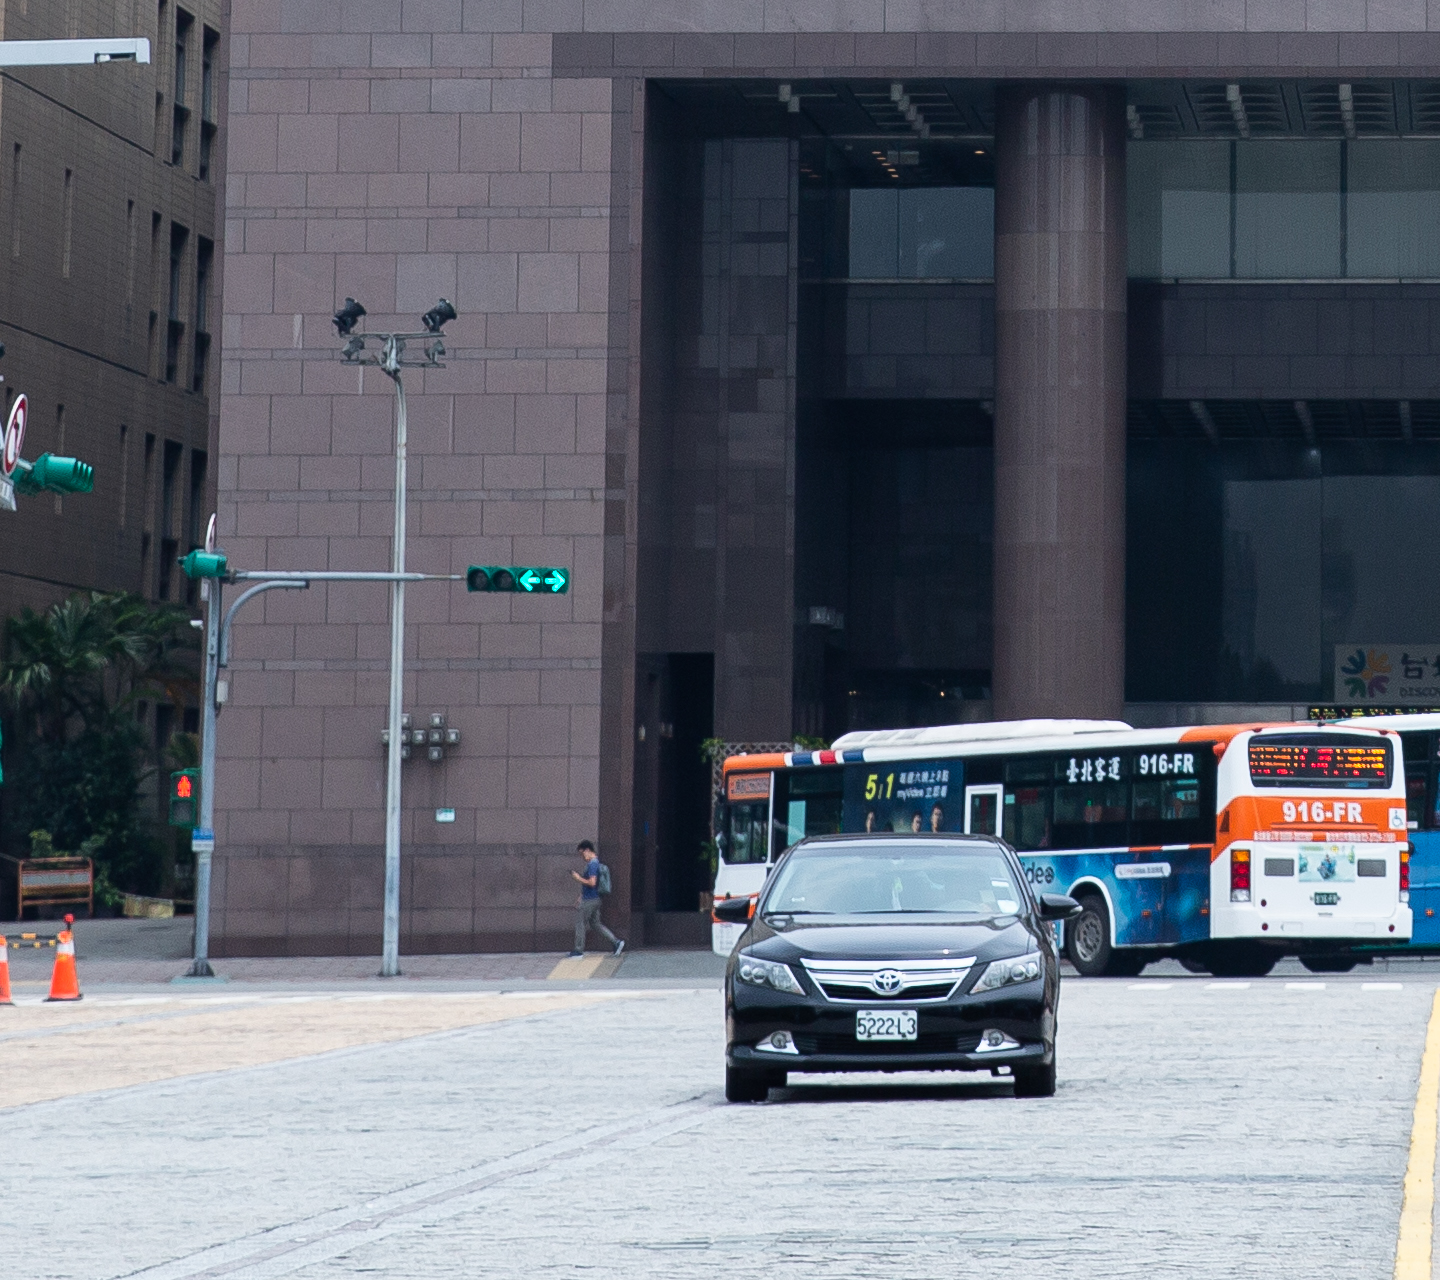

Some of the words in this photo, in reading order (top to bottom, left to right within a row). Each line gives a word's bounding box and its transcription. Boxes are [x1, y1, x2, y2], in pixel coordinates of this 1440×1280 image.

[1066, 756, 1121, 783] 臺北客運
[1139, 753, 1194, 775] 916-FR
[1282, 800, 1363, 823] 916-FR
[858, 1017, 916, 1036] 5222-L3
